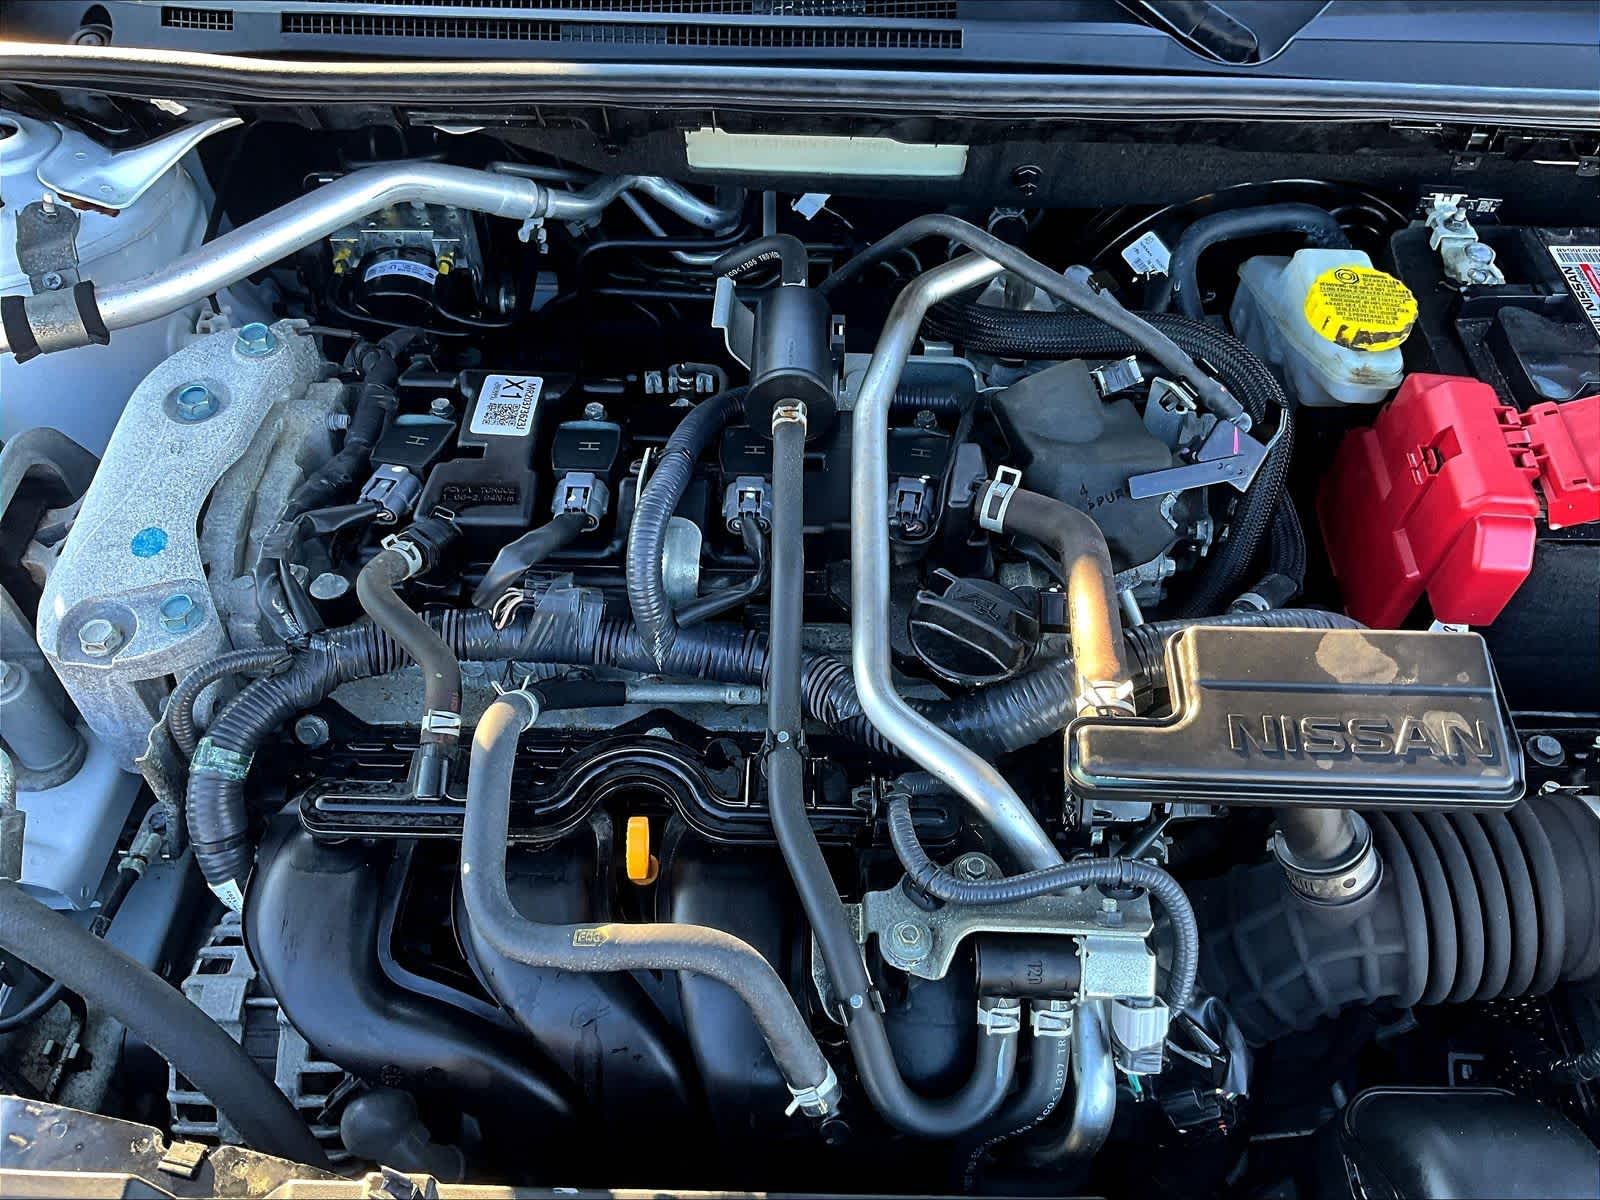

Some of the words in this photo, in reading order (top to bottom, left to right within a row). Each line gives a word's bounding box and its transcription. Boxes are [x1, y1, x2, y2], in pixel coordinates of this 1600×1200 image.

[1561, 265, 1598, 312] NISSAN
[500, 378, 527, 399] X1
[1227, 712, 1494, 758] NISSAN
